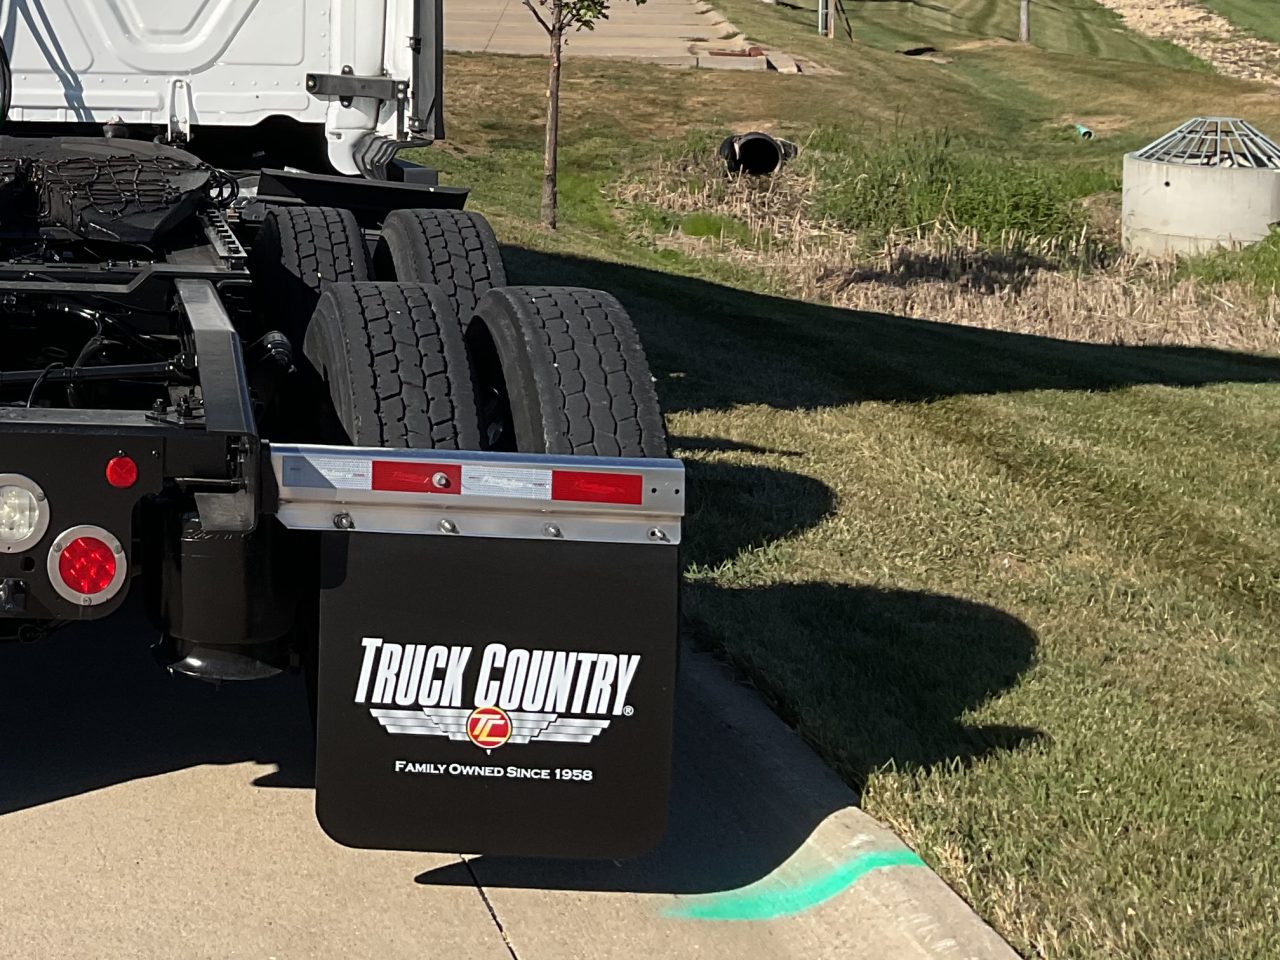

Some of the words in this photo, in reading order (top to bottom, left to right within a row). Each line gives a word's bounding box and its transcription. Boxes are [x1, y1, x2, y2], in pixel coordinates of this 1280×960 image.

[355, 637, 472, 707] TRUCK
[395, 760, 447, 775] FAMILY
[448, 763, 505, 777] OWNED
[506, 766, 551, 779] SINCE
[554, 768, 593, 781] 1958
